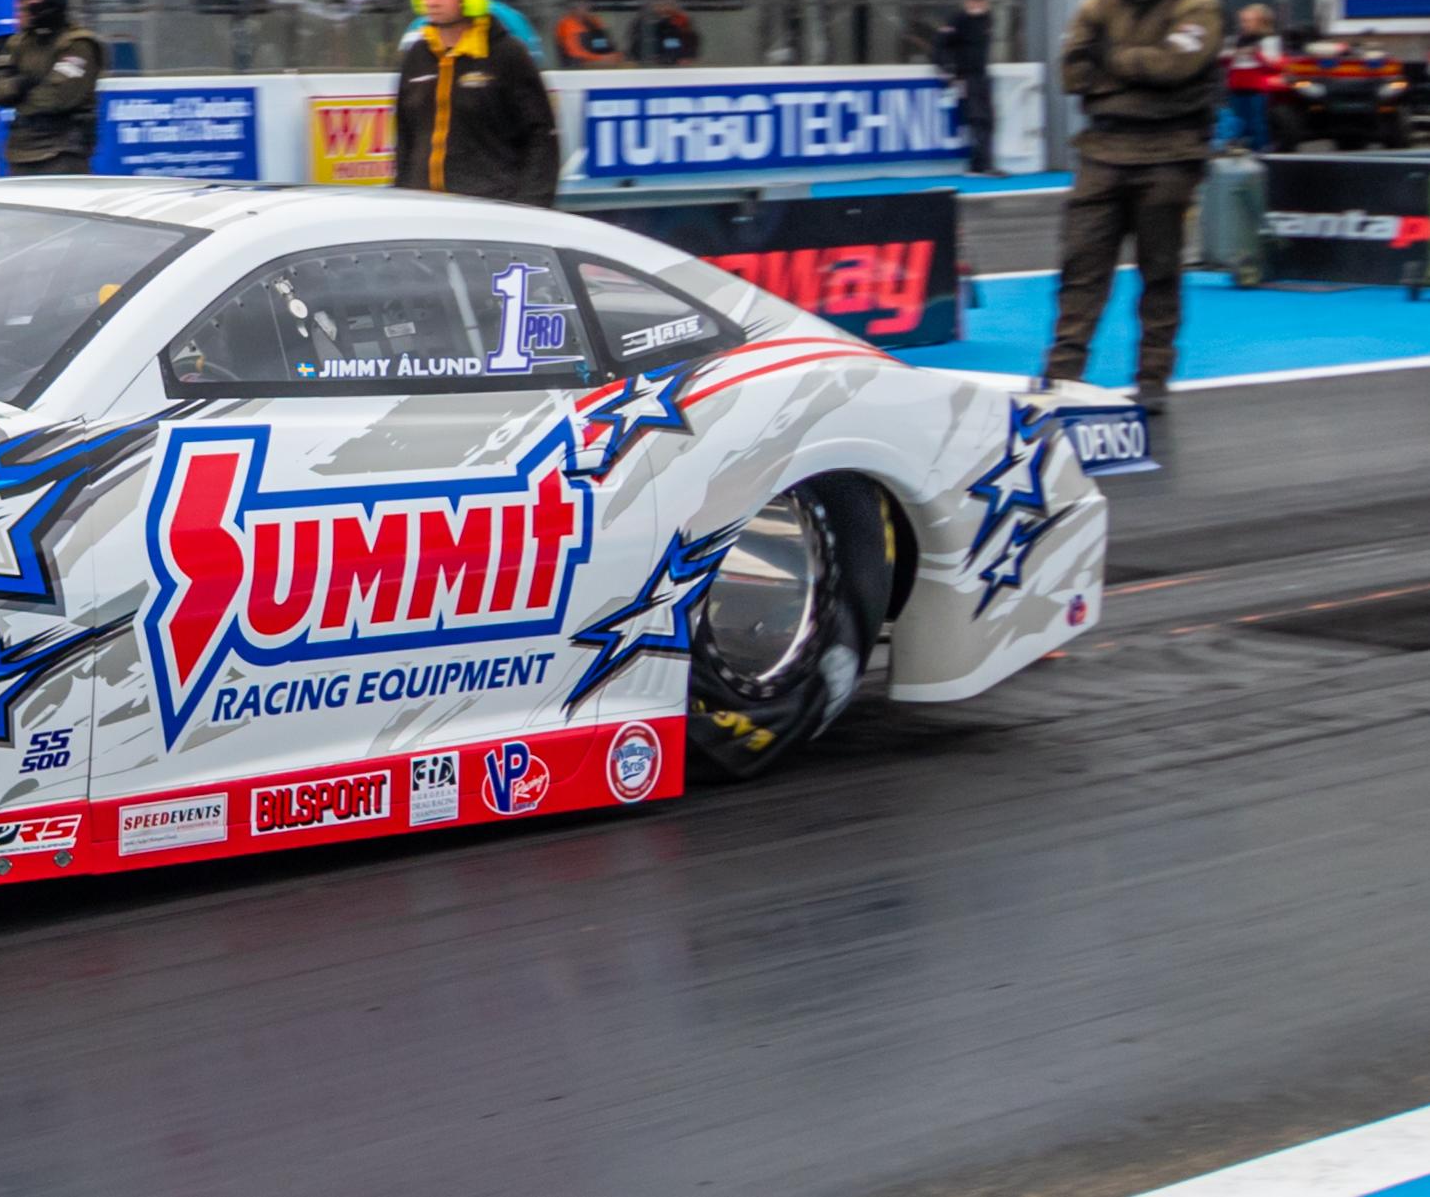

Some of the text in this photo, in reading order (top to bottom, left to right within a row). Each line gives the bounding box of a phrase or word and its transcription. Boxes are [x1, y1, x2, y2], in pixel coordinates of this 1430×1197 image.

[588, 87, 968, 168] TURBO TECHNIC
[486, 263, 567, 374] 1 PRO
[319, 353, 482, 379] JIMMY ÅLUND
[1075, 420, 1146, 462] DENSO
[211, 652, 555, 722] RACING EQUIPMENT
[18, 751, 71, 774] 500
[26, 728, 74, 755] SS
[256, 773, 388, 832] BILSPORT
[486, 742, 529, 813] VP
[123, 804, 222, 831] SPEEDEVENTS
